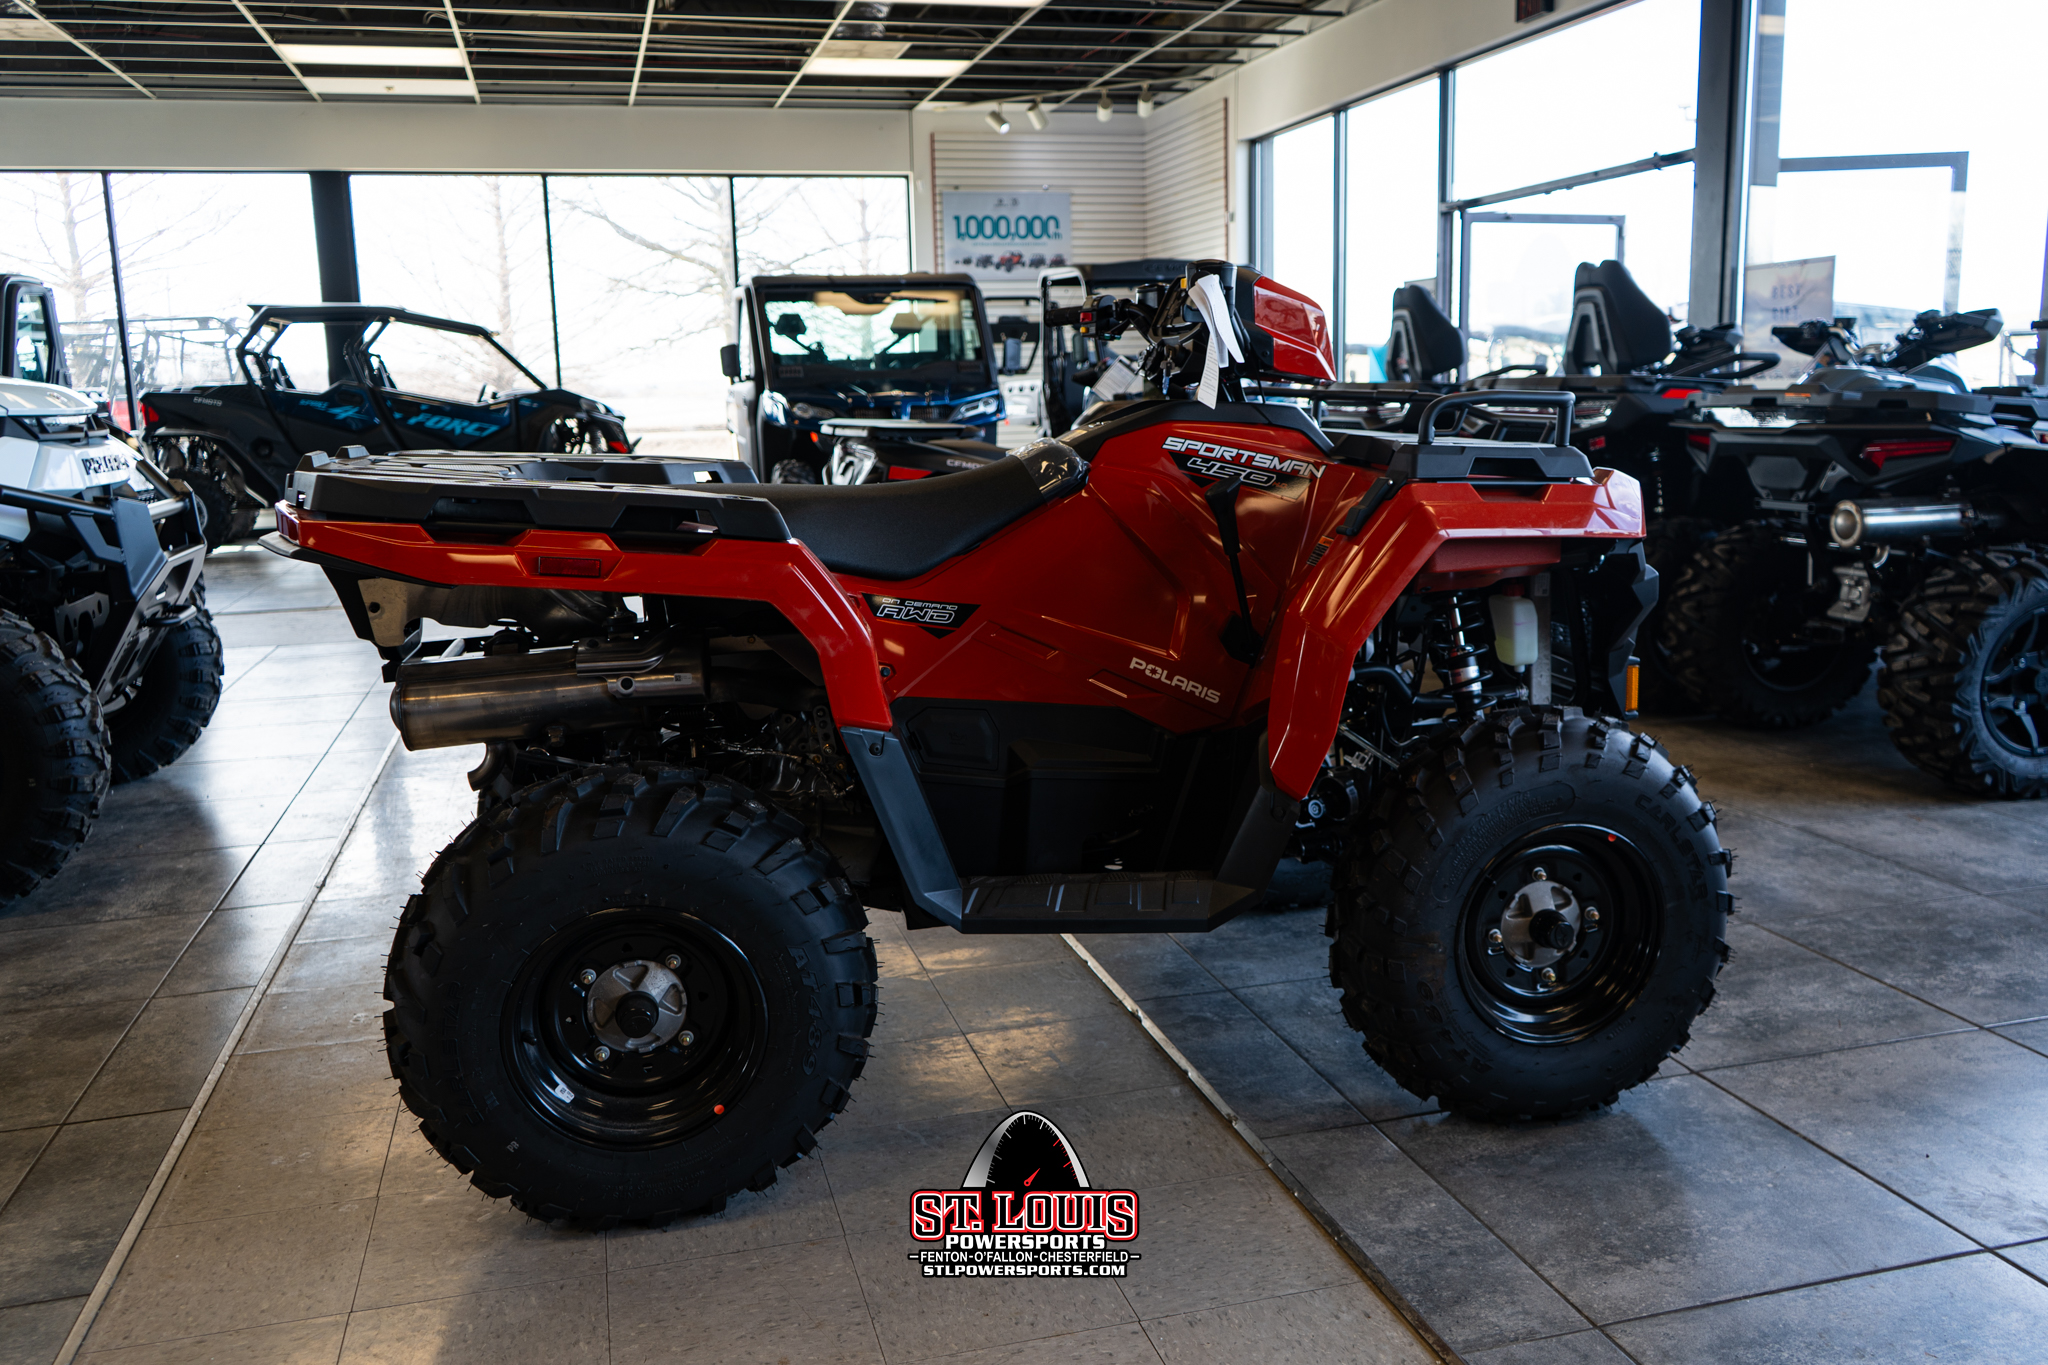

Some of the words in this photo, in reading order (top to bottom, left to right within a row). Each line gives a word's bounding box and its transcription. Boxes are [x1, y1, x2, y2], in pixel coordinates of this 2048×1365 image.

[1161, 436, 1328, 479] SPORTSMAN
[1187, 457, 1277, 487] 450
[876, 604, 955, 624] AWD
[882, 597, 901, 605] ON
[904, 600, 958, 611] DEMAND
[1129, 656, 1221, 704] POLARIS
[1635, 794, 1708, 904] CARLSTAR
[785, 945, 822, 1077] AT489
